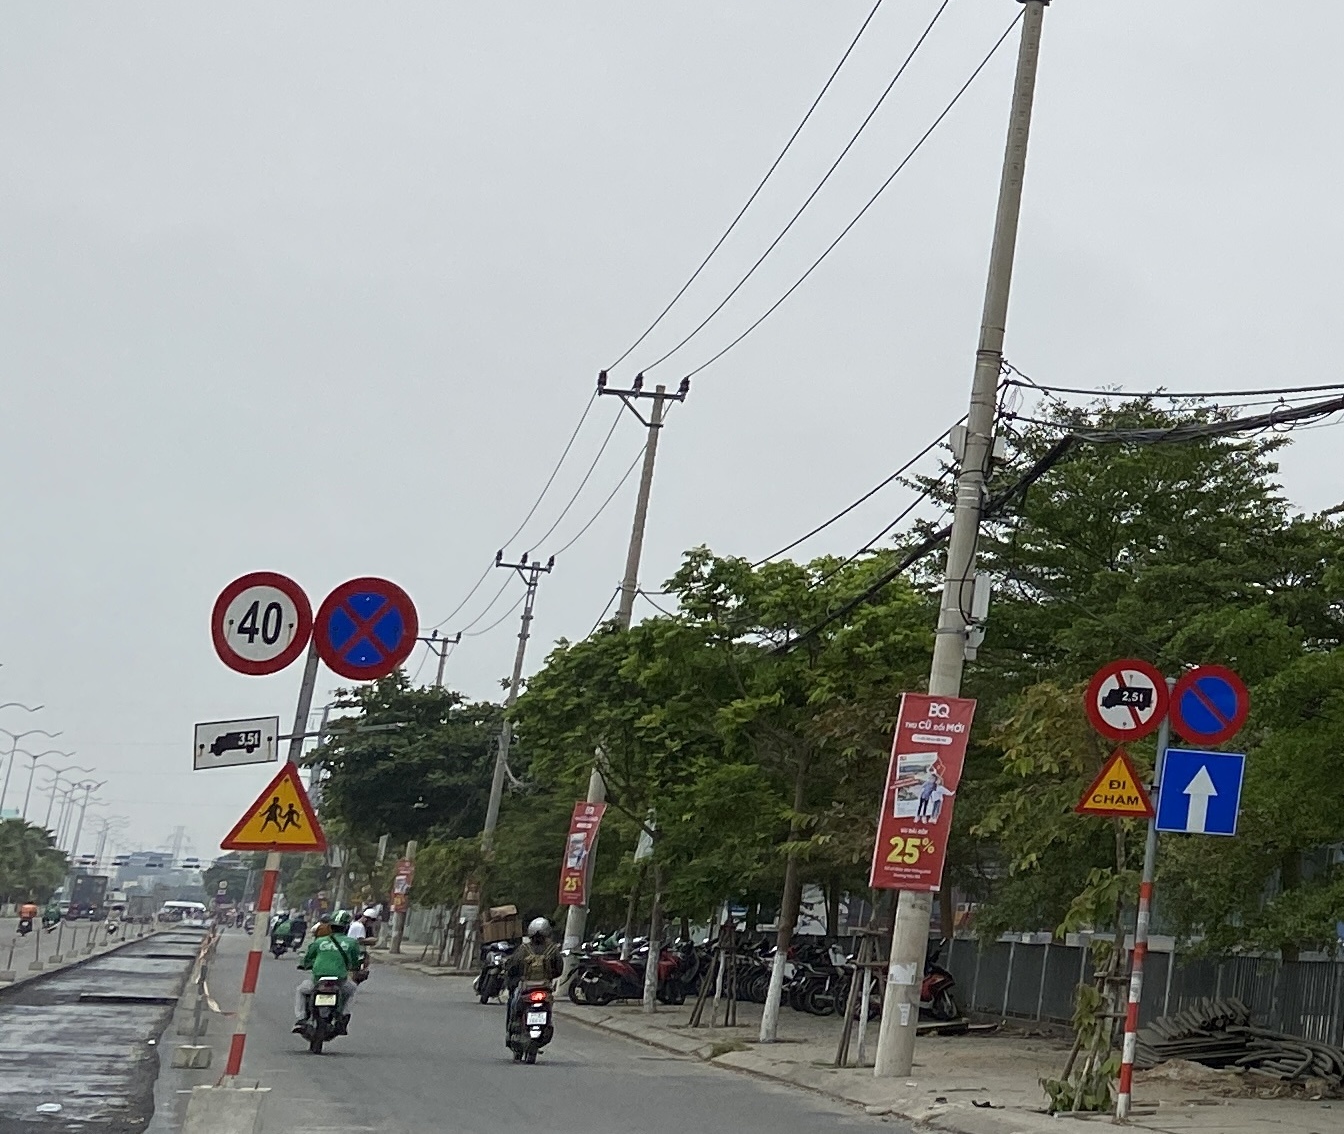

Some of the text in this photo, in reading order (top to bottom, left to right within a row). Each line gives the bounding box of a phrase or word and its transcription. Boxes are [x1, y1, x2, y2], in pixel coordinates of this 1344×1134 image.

[237, 600, 283, 645] 40
[928, 702, 950, 718] BQ
[1109, 779, 1126, 790] ĐI
[886, 836, 935, 864] 25%
